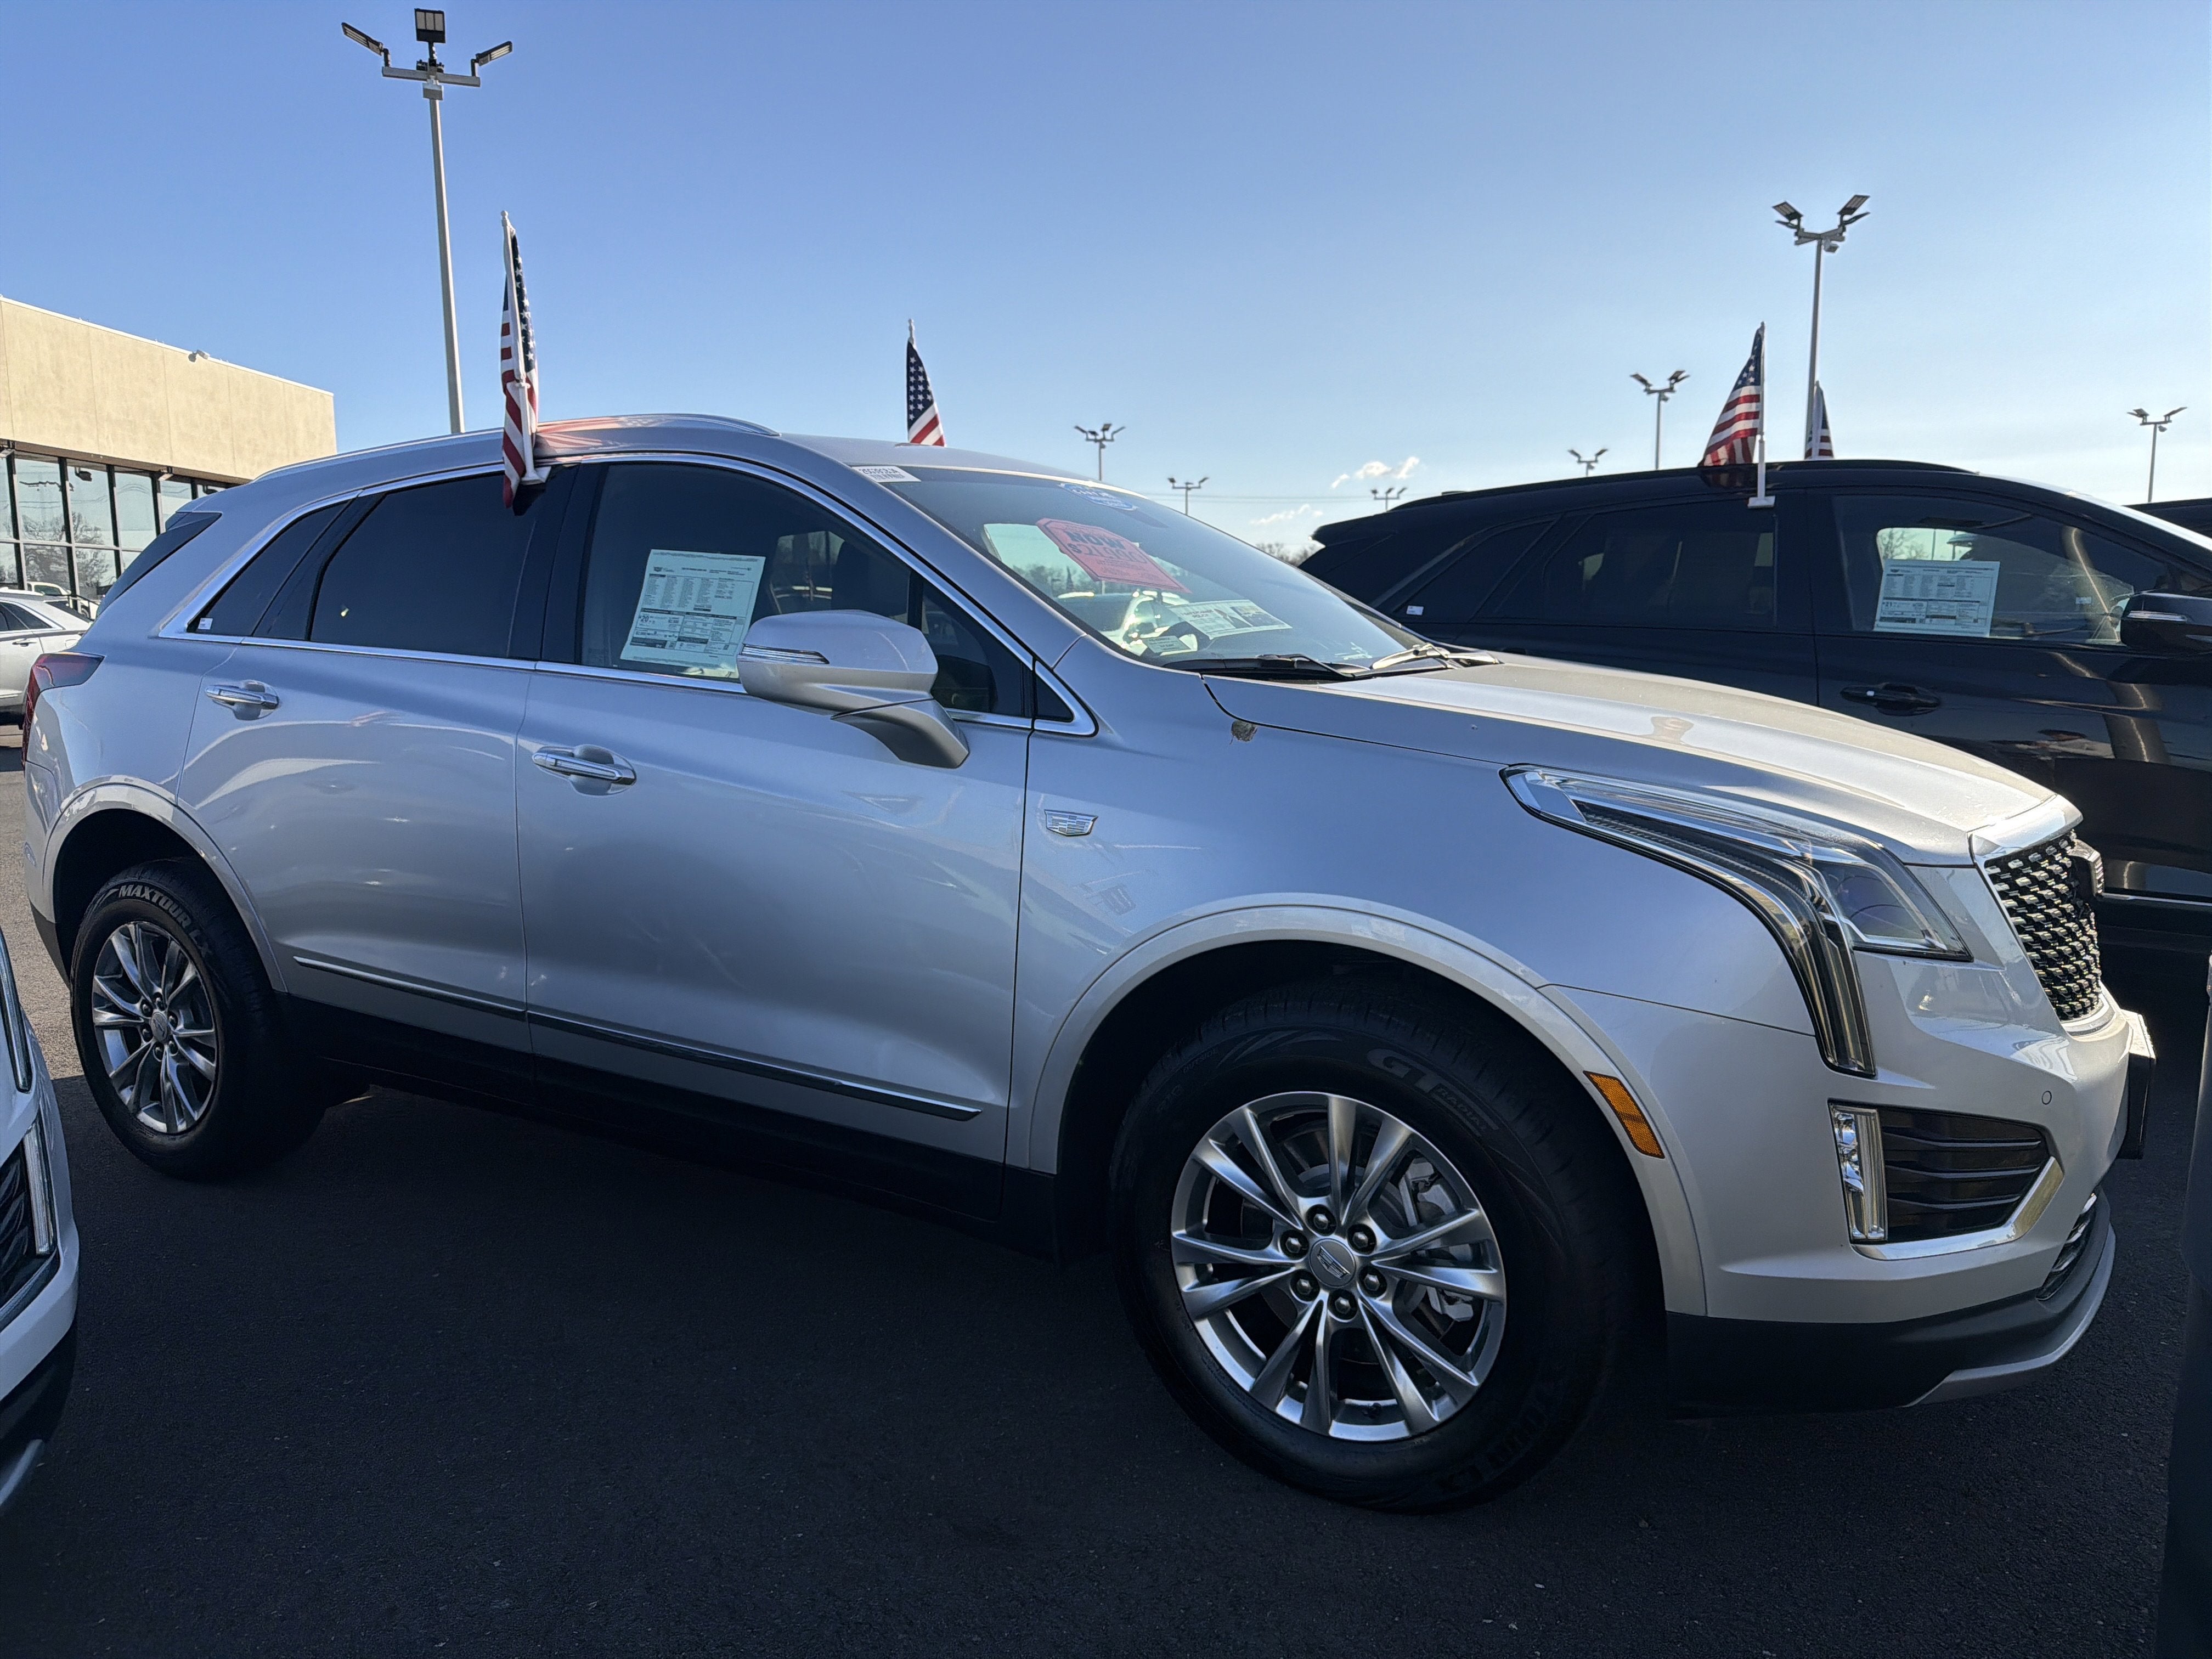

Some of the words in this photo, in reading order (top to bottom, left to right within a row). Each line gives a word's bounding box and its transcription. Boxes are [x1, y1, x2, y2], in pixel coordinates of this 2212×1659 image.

[1063, 531, 1126, 549] NOW
[119, 884, 192, 927] MAXTOUR
[188, 929, 213, 958] LX
